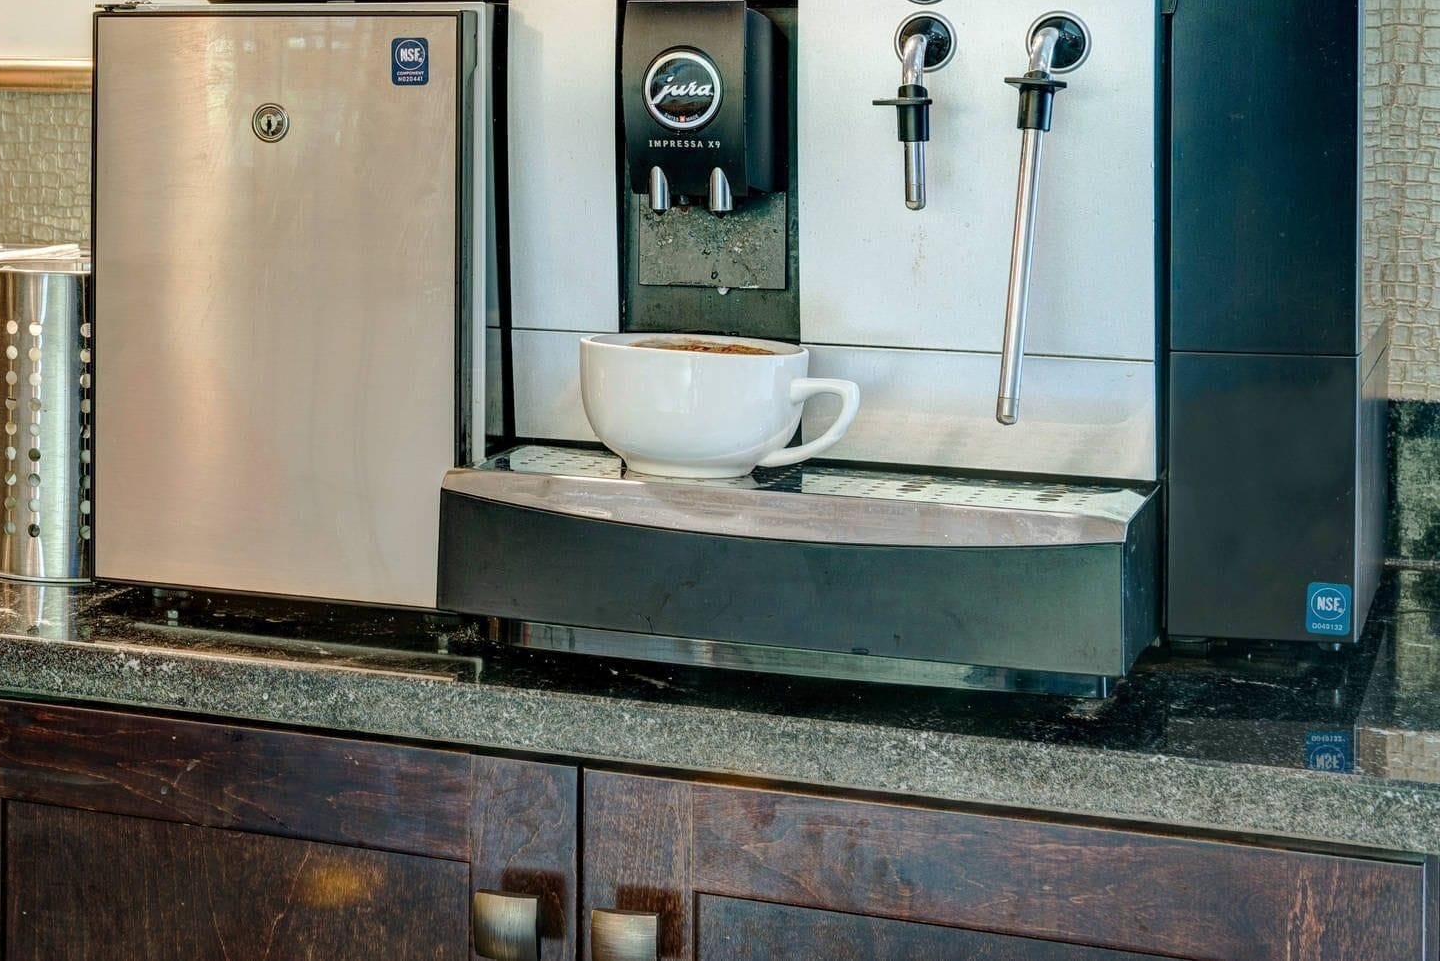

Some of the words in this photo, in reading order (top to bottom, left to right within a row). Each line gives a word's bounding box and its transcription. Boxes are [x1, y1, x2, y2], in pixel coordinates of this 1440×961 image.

[400, 48, 421, 62] NSF
[652, 76, 714, 105] jura
[648, 139, 704, 148] IMPRESSA
[708, 140, 721, 149] X9
[1317, 596, 1342, 611] NSF
